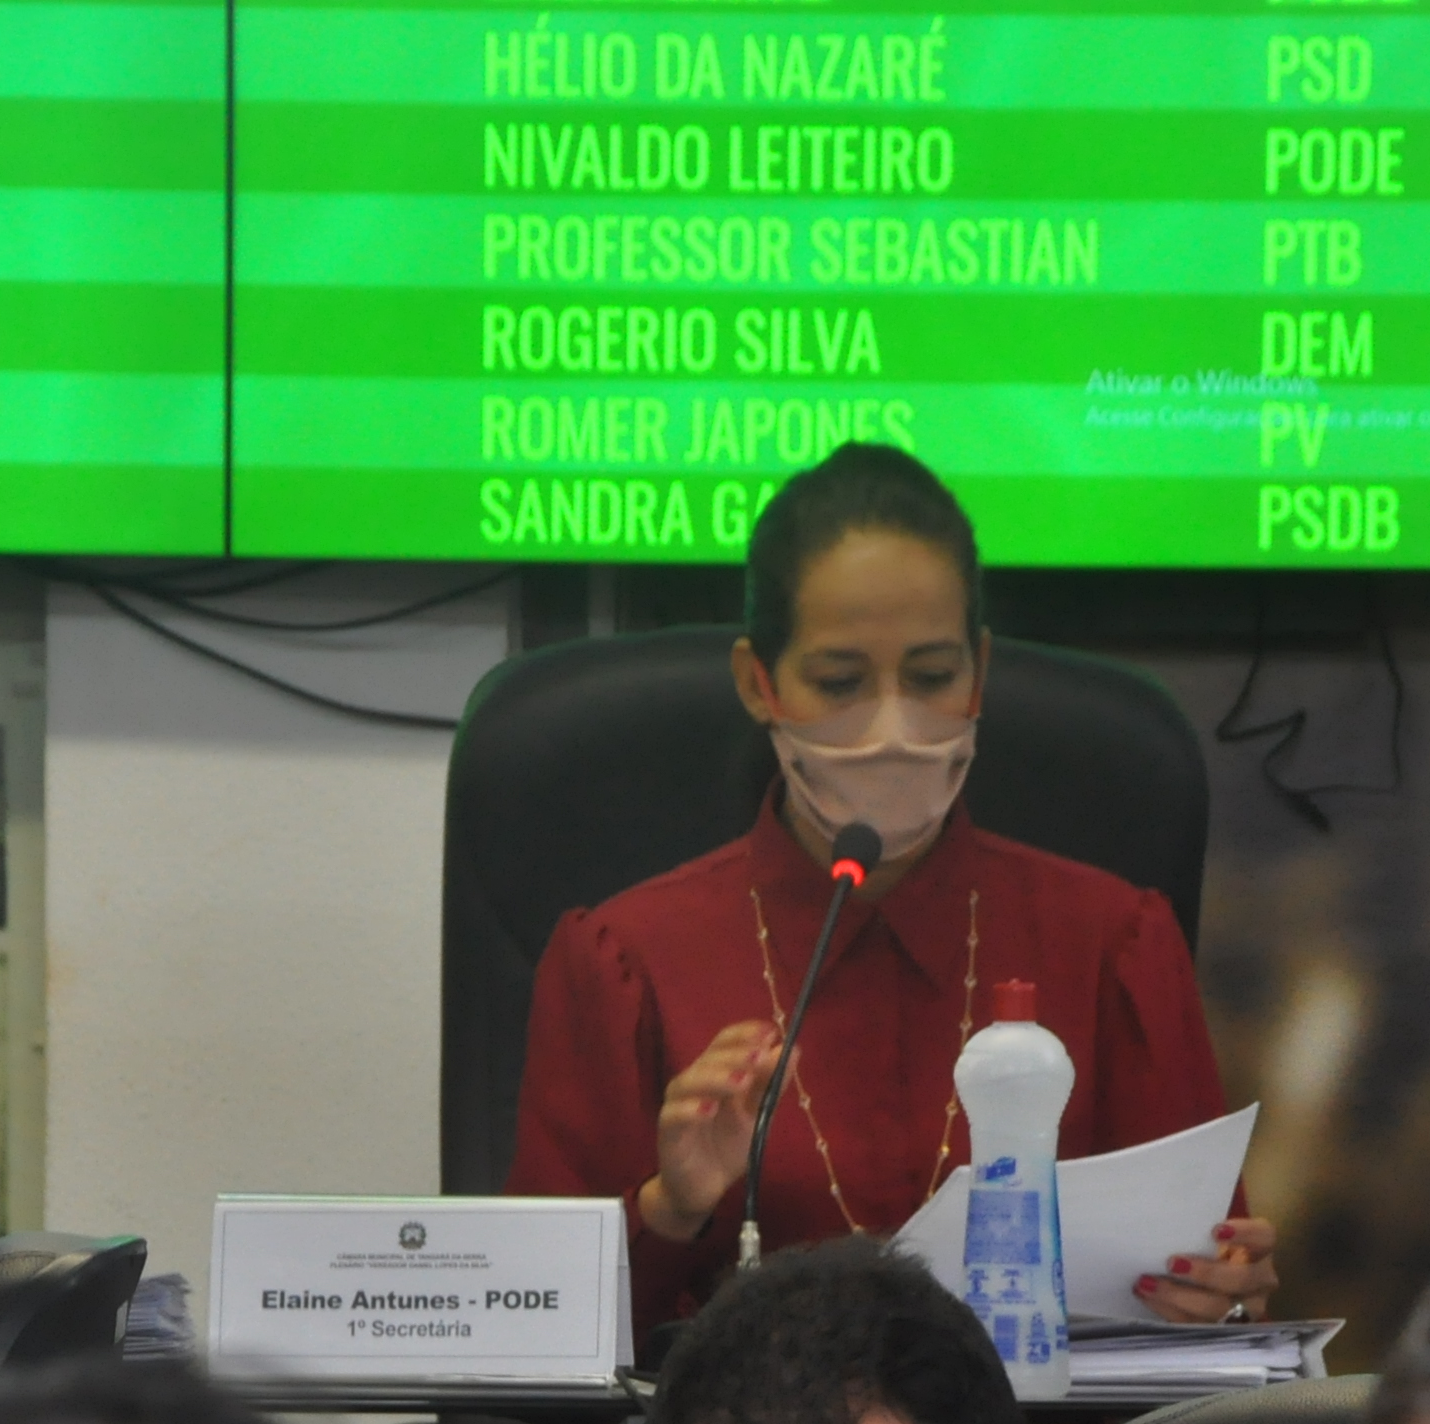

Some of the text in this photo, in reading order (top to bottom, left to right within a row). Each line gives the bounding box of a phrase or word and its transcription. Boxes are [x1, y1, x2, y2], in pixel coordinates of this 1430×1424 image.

[483, 8, 947, 104] HÉLIO DA NAZARÉ
[1266, 35, 1373, 104] PSD
[483, 124, 954, 193] NIVALDO LEITEIRO
[1265, 128, 1405, 195] PODE
[482, 214, 1100, 286] PROFESSOR SEBASTIAN
[1263, 219, 1363, 287] PTB
[481, 305, 882, 374] ROGERIO SILVA
[1261, 311, 1374, 379] DEM
[1196, 367, 1319, 396] Windows
[480, 395, 670, 463] ROMER
[1259, 402, 1330, 468] PV
[479, 478, 694, 547] SANDRA
[1257, 484, 1401, 552] PSDB
[261, 1289, 342, 1311] Elaine
[351, 1290, 460, 1311] Antunes
[485, 1290, 559, 1311] PODE
[371, 1319, 471, 1338] Secretária
